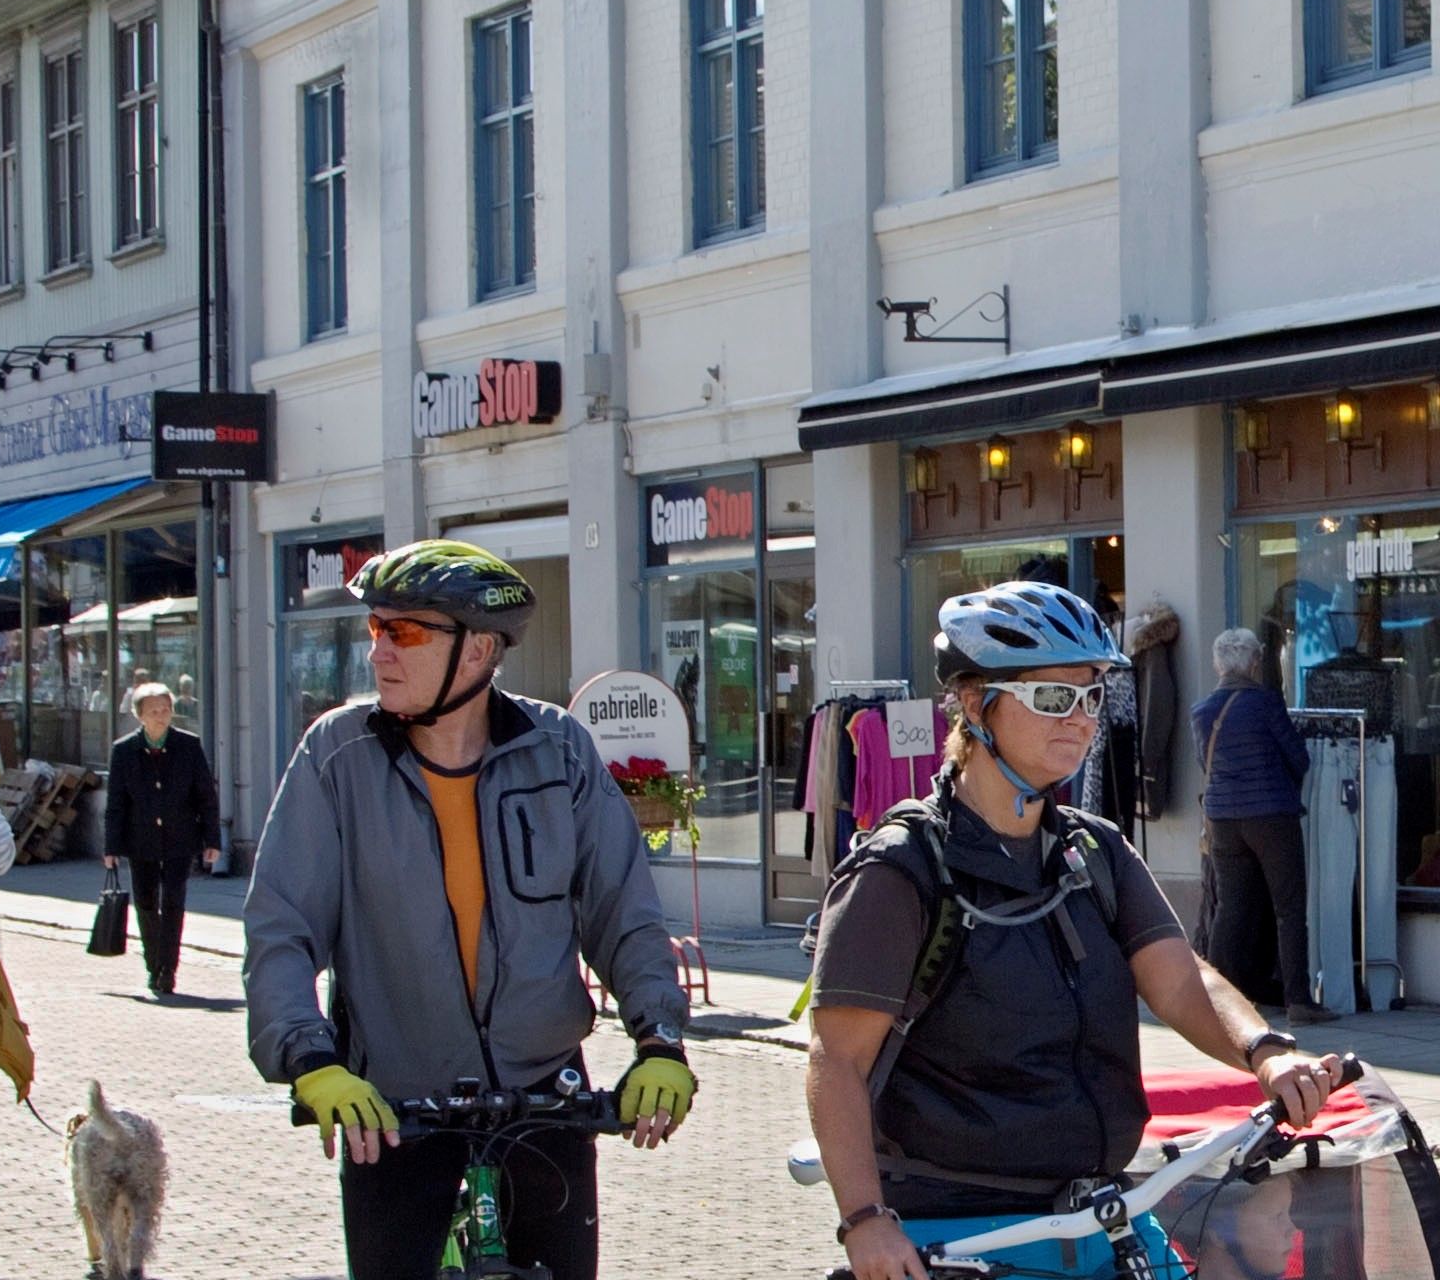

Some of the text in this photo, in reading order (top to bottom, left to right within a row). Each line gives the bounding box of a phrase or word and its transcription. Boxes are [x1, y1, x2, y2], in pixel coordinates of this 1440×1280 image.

[413, 357, 538, 439] GameStop
[162, 425, 258, 444] GameStop
[651, 485, 753, 545] GameStop
[1346, 529, 1414, 582] gabrielle
[589, 692, 658, 725] gabrielle
